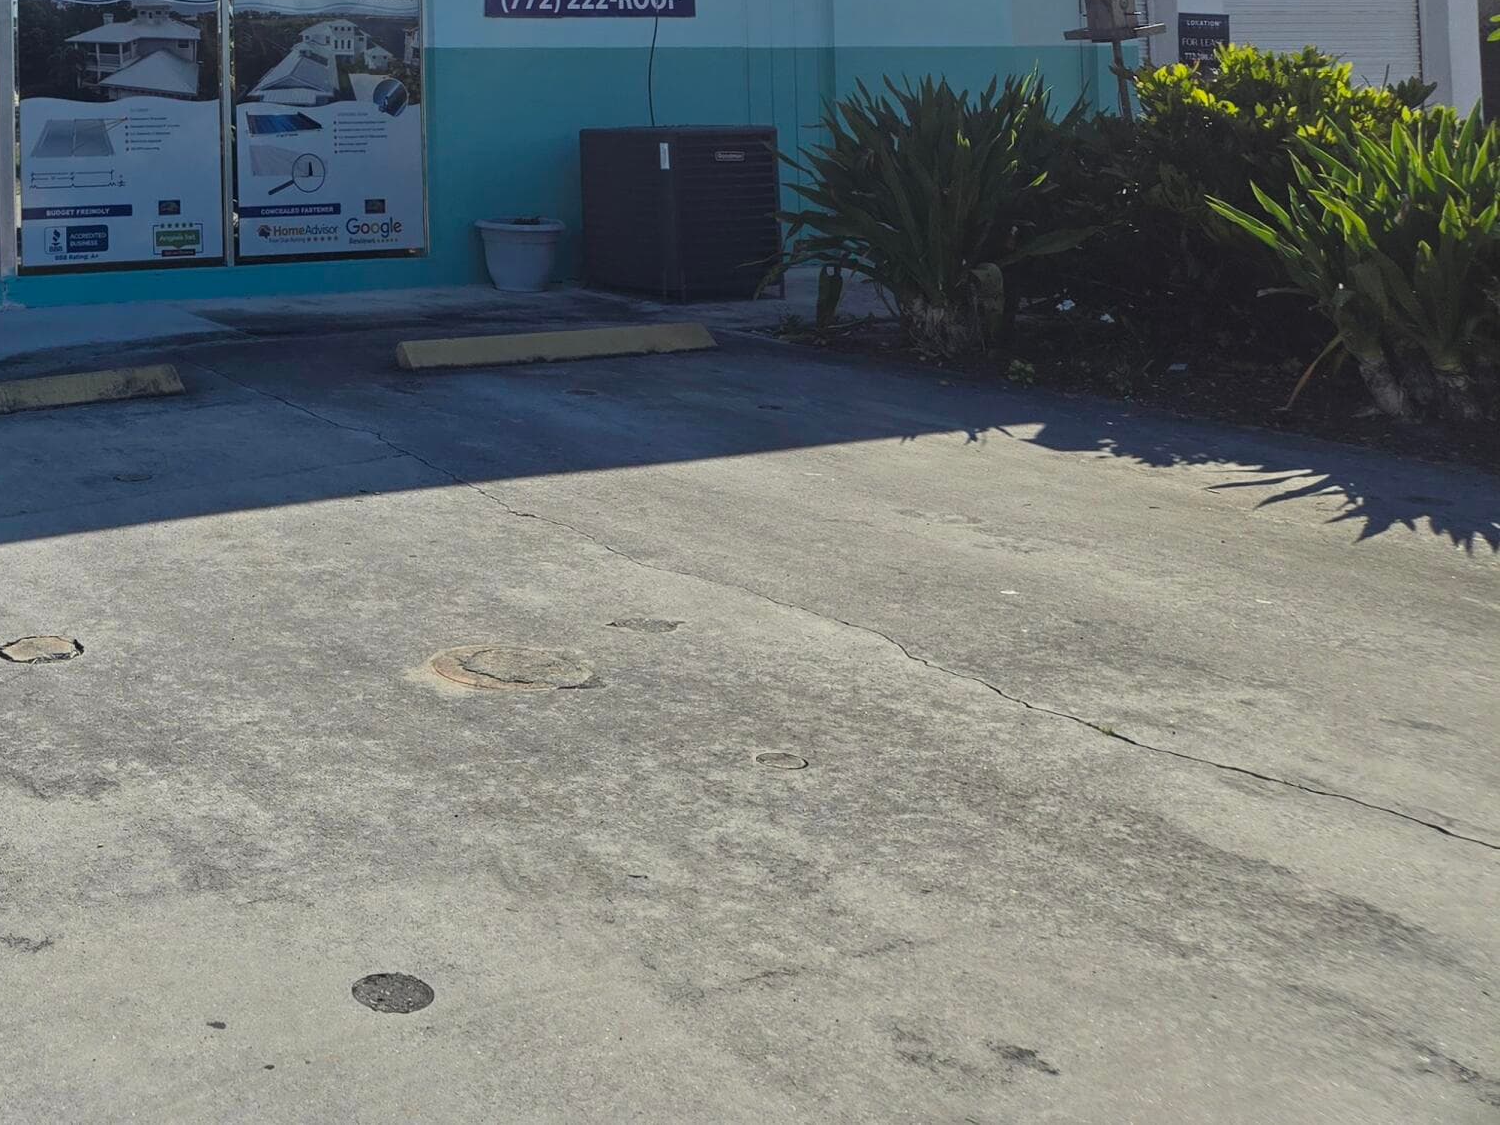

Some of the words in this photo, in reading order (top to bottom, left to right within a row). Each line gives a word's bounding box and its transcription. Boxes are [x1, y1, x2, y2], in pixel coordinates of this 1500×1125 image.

[46, 209, 74, 217] BUDGET
[273, 223, 339, 236] HomeAdvisor
[346, 216, 402, 238] Google
